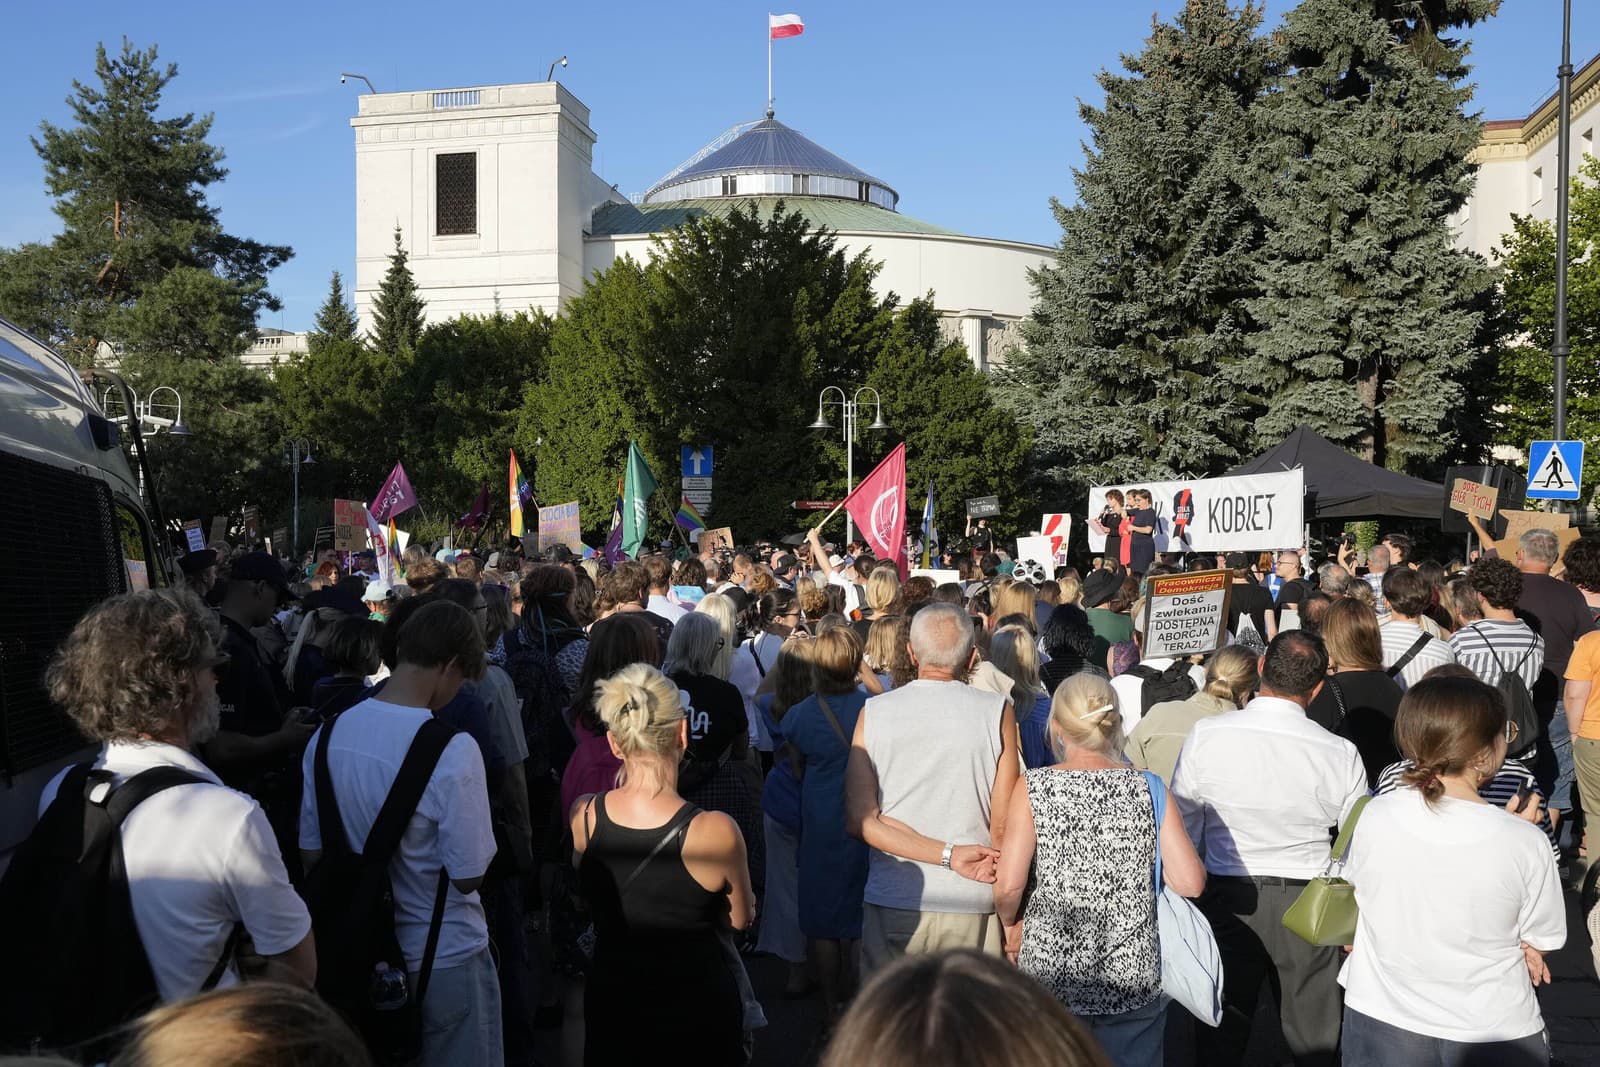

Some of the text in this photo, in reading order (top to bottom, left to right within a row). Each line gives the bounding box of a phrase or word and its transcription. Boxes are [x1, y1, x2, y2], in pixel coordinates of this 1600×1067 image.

[1208, 493, 1276, 534] KOBIET
[1157, 575, 1222, 588] Pracownicza
[1160, 583, 1219, 594] Demokracja
[1172, 594, 1205, 606] Dość
[1155, 603, 1218, 618] zwlekania
[1155, 616, 1215, 631] DOSTĘPNA
[1157, 627, 1210, 641] ABORCJA
[1164, 640, 1202, 651] TERAZ!
